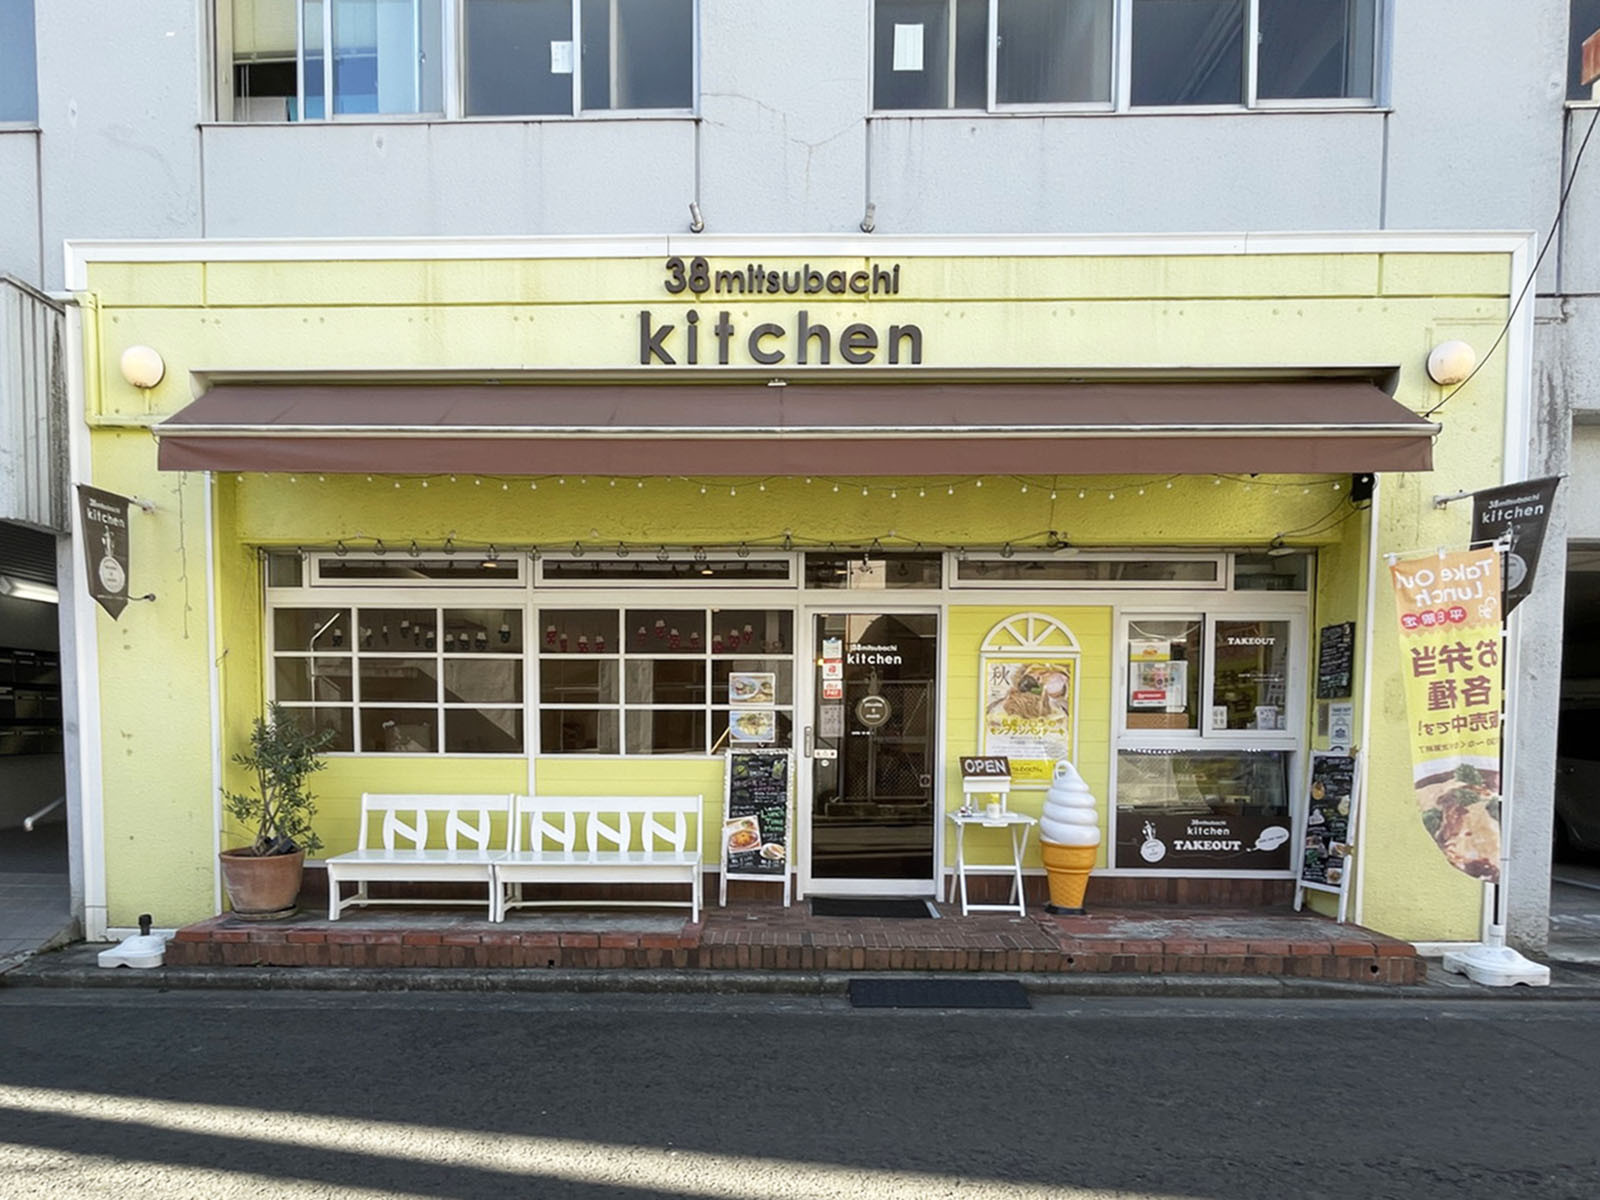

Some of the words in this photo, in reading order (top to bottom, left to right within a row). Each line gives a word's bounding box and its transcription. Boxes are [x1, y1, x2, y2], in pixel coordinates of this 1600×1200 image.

[665, 256, 900, 294] 38mitsubachi
[640, 310, 923, 365] kitchen
[86, 507, 125, 528] kitchen
[1482, 504, 1544, 524] kitchen
[1227, 636, 1276, 645] TAKEOUT
[847, 653, 902, 665] kitchen
[992, 666, 1010, 685] 秋
[964, 759, 1008, 774] OPEN
[1186, 826, 1230, 836] kitchen
[1173, 840, 1242, 852] TAKEOUT
